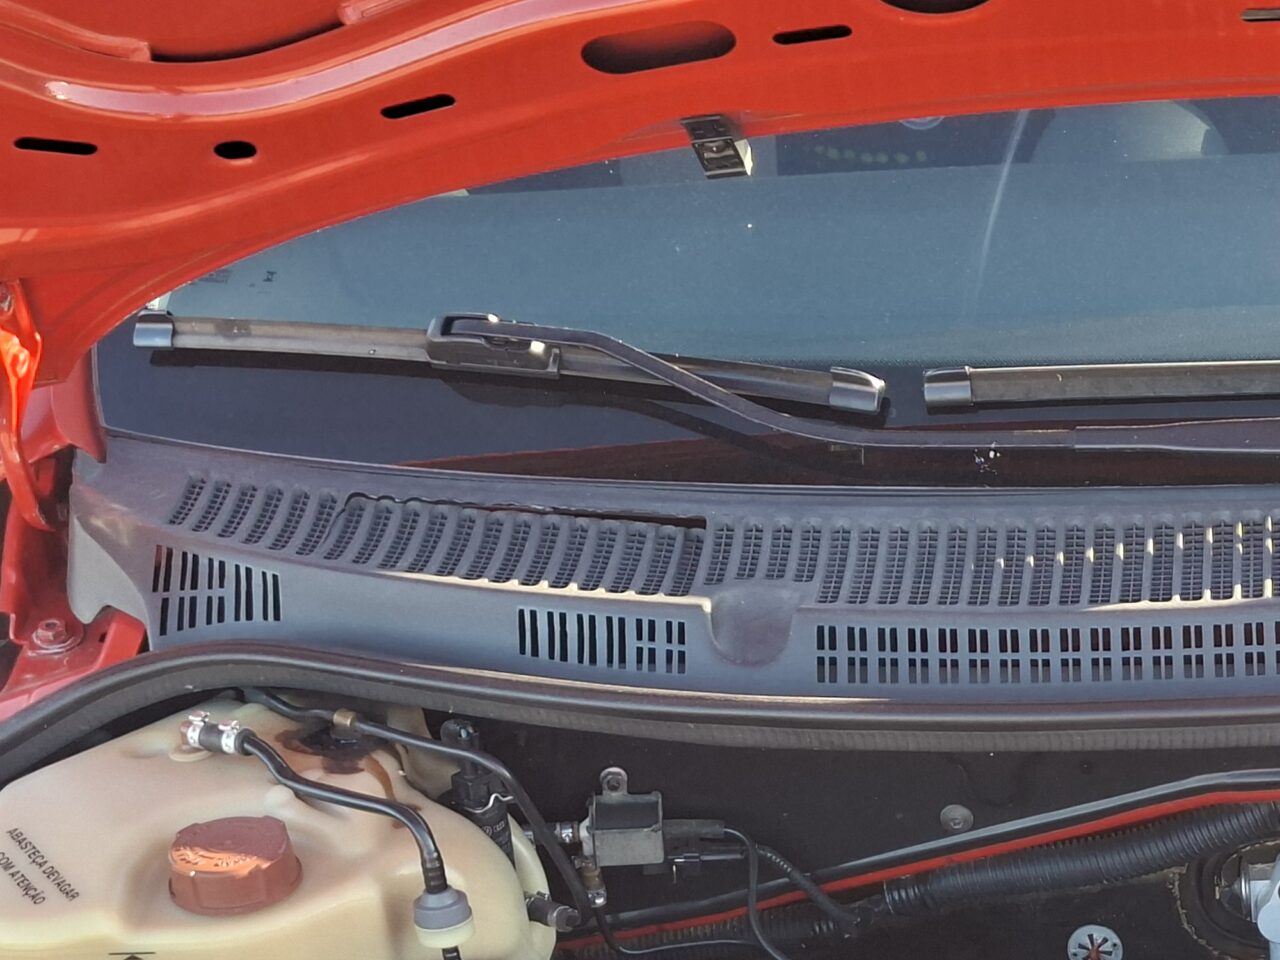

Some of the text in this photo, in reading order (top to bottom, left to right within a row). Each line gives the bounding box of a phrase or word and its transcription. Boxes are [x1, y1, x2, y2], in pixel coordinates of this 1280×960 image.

[6, 827, 80, 902] ABASTEÇA DEVAGAR
[8, 870, 46, 905] ATENÇÃO
